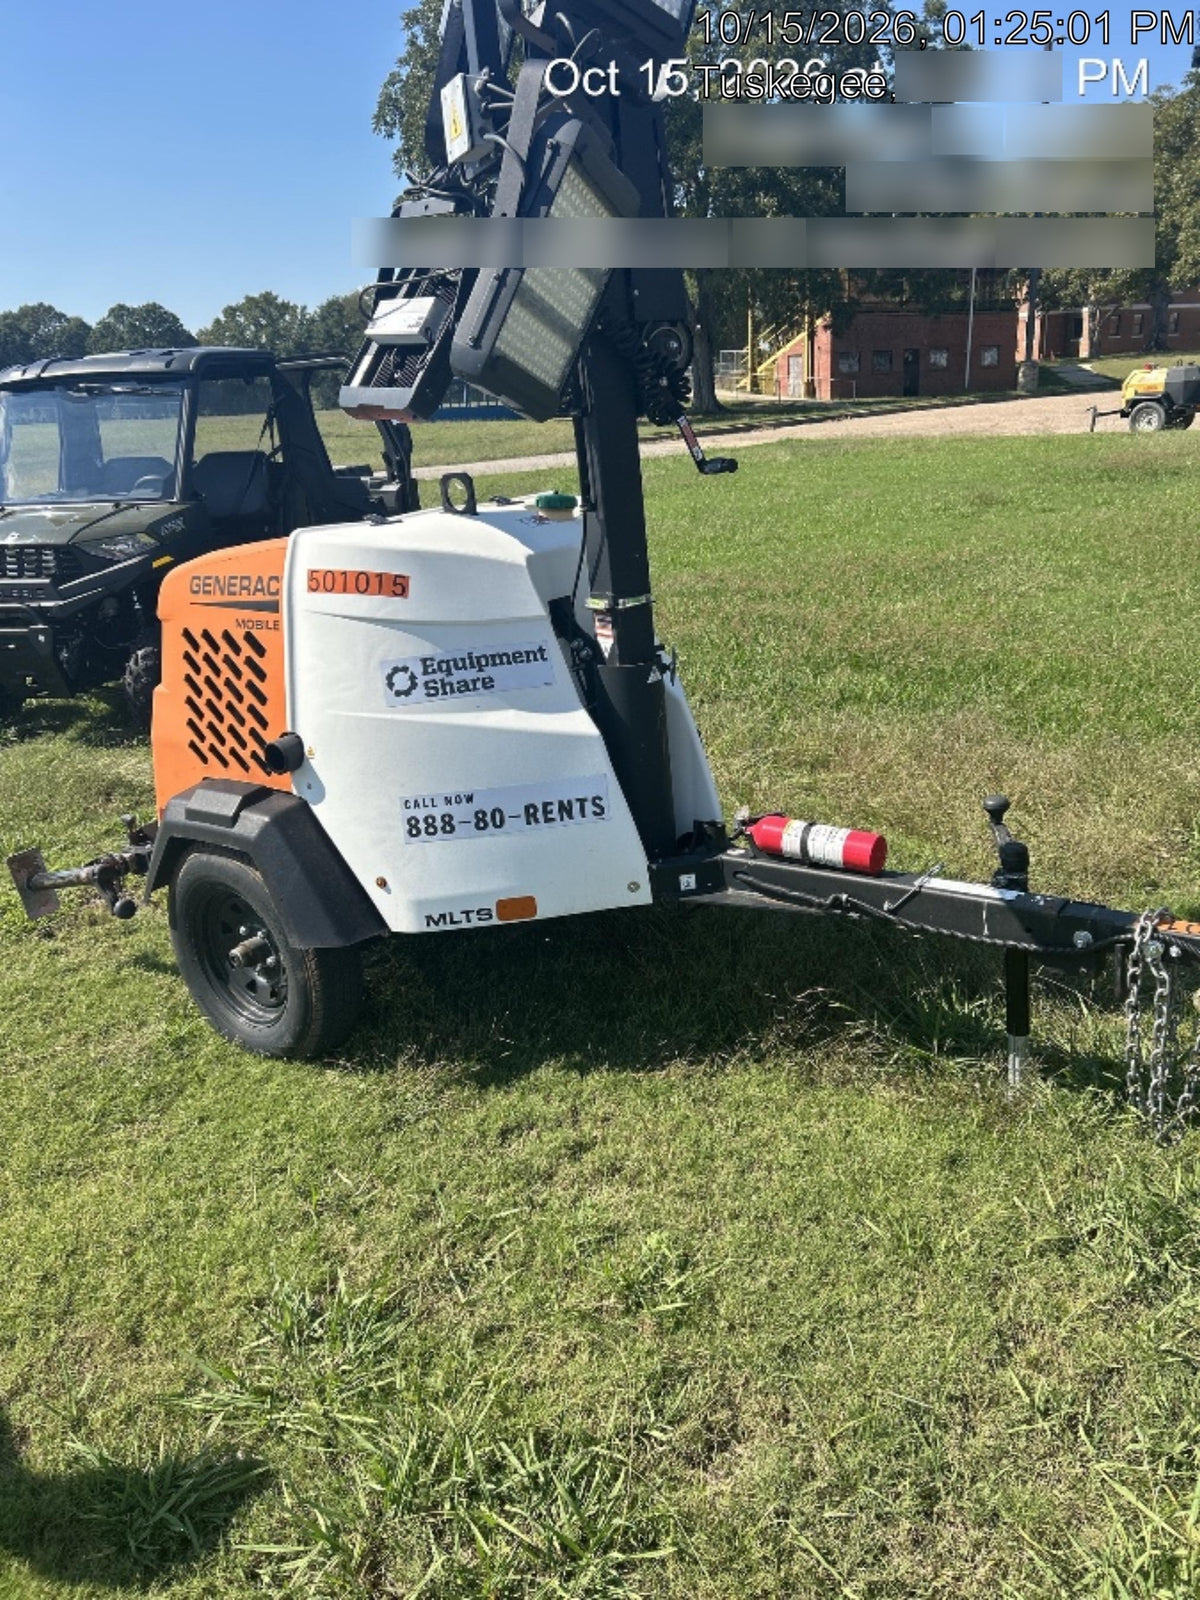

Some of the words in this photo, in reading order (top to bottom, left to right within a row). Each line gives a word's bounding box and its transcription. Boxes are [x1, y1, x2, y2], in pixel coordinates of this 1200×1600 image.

[190, 575, 280, 596] GENERAC
[307, 571, 407, 597] 501015
[235, 618, 280, 631] MOBILE
[420, 645, 548, 677] Equipment
[423, 675, 495, 697] Share
[404, 798, 438, 809] CALL
[444, 793, 474, 806] NOW
[406, 795, 606, 838] 888-80-RENTS
[424, 908, 494, 927] MLTS
